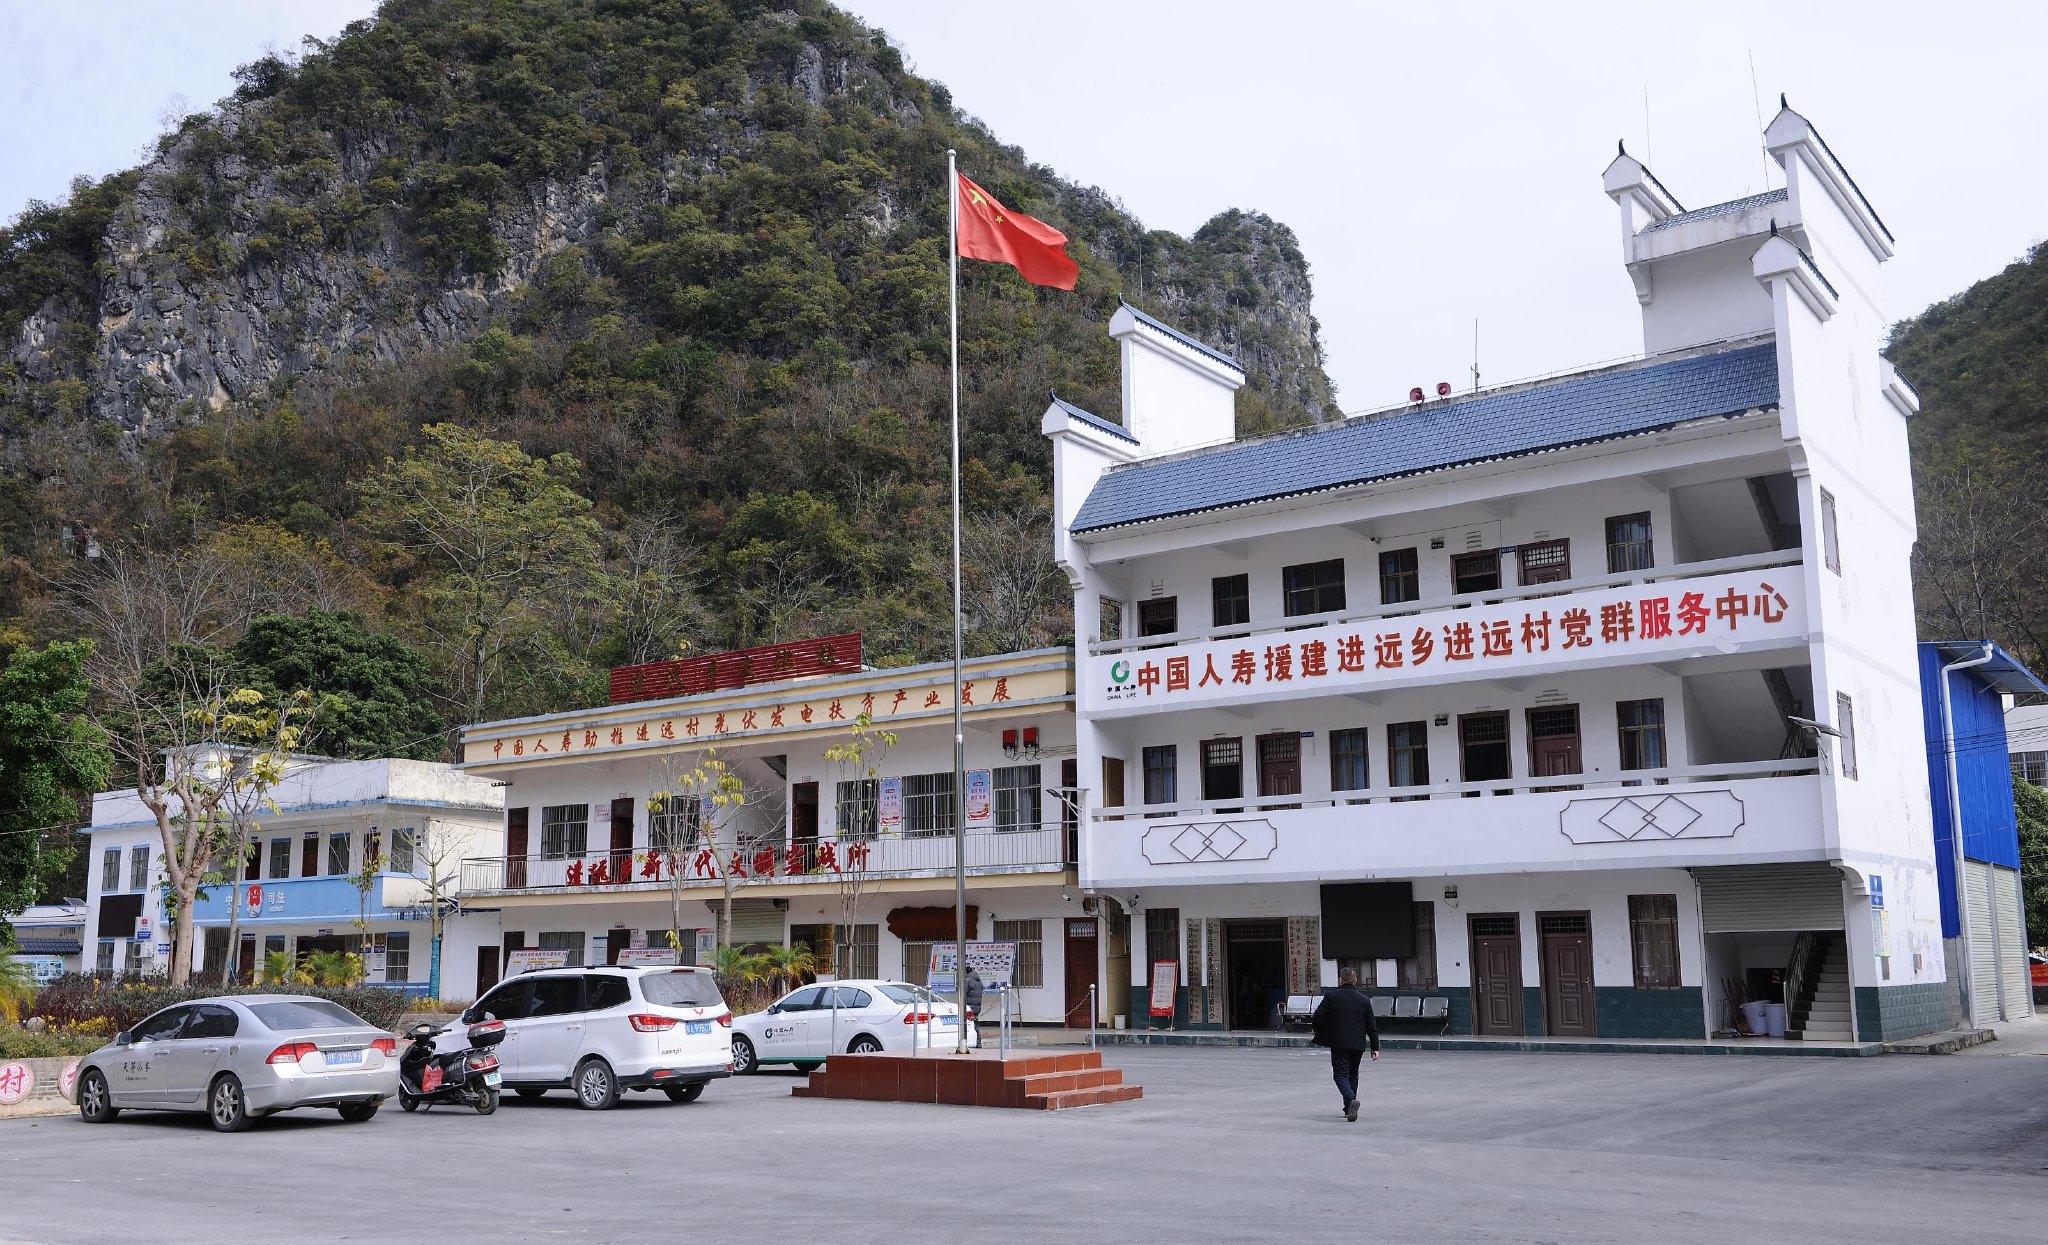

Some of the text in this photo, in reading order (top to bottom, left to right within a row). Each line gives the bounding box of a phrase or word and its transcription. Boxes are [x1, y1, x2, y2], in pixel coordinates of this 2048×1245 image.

[1137, 581, 1789, 696] 中国人寿援建进远乡进远村党群服务中心
[493, 677, 1012, 760] 中国人寿助推进远村光伏发电扶贫产业发展
[0, 1066, 26, 1094] 村
